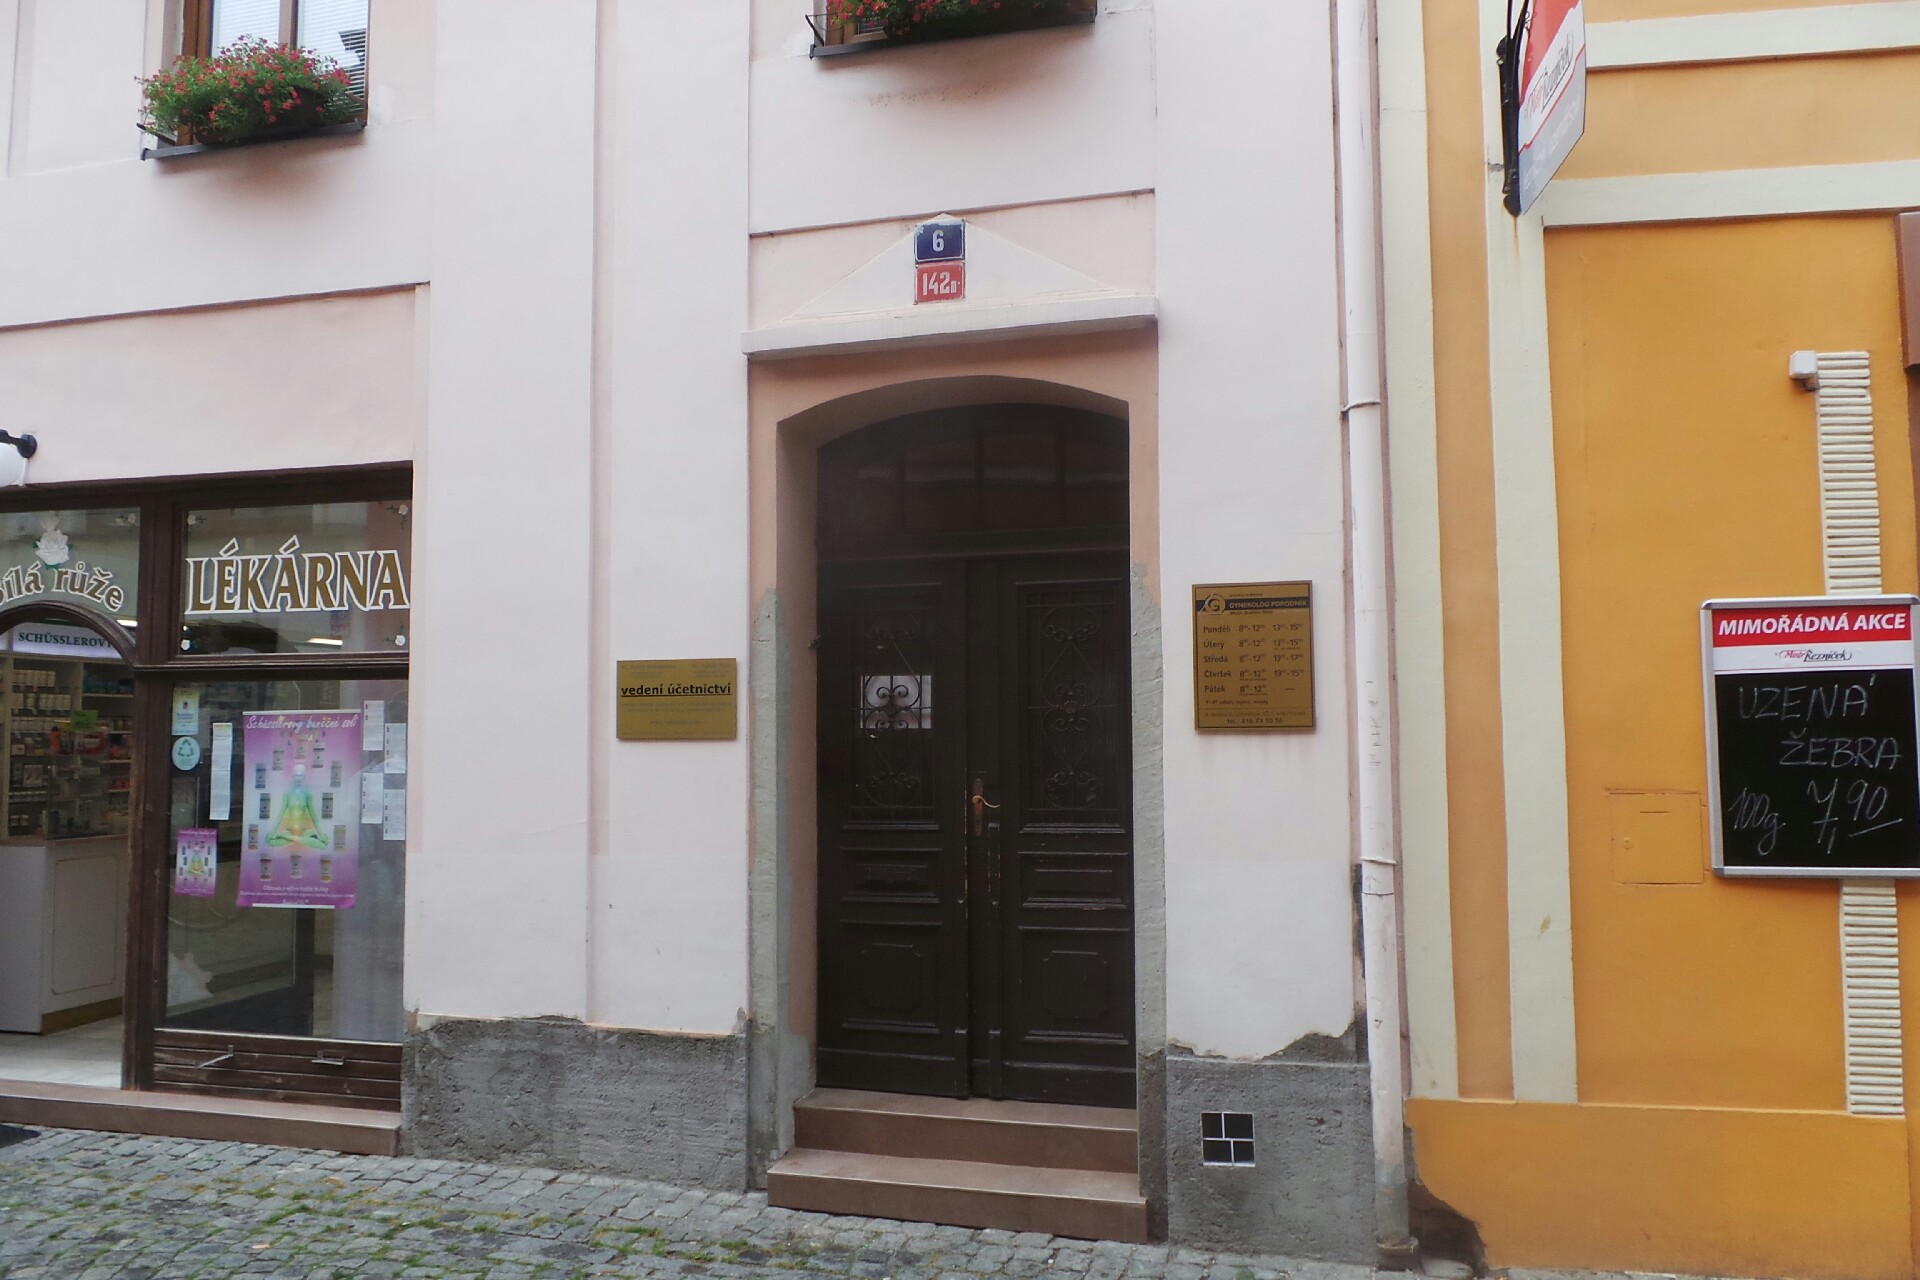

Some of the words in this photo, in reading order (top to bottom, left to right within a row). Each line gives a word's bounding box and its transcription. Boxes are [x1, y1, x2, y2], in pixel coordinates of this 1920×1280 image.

[933, 230, 944, 252] 6
[51, 561, 124, 612] růže
[184, 535, 410, 615] LÉKÁRNA
[1718, 613, 1849, 636] MIMOŘÁDNÁ
[1853, 613, 1907, 631] AKCE
[621, 684, 663, 695] vedení
[667, 683, 732, 695] účetnictví
[1739, 673, 1877, 721] UZENÁ
[1779, 727, 1903, 770] ŽEBRA
